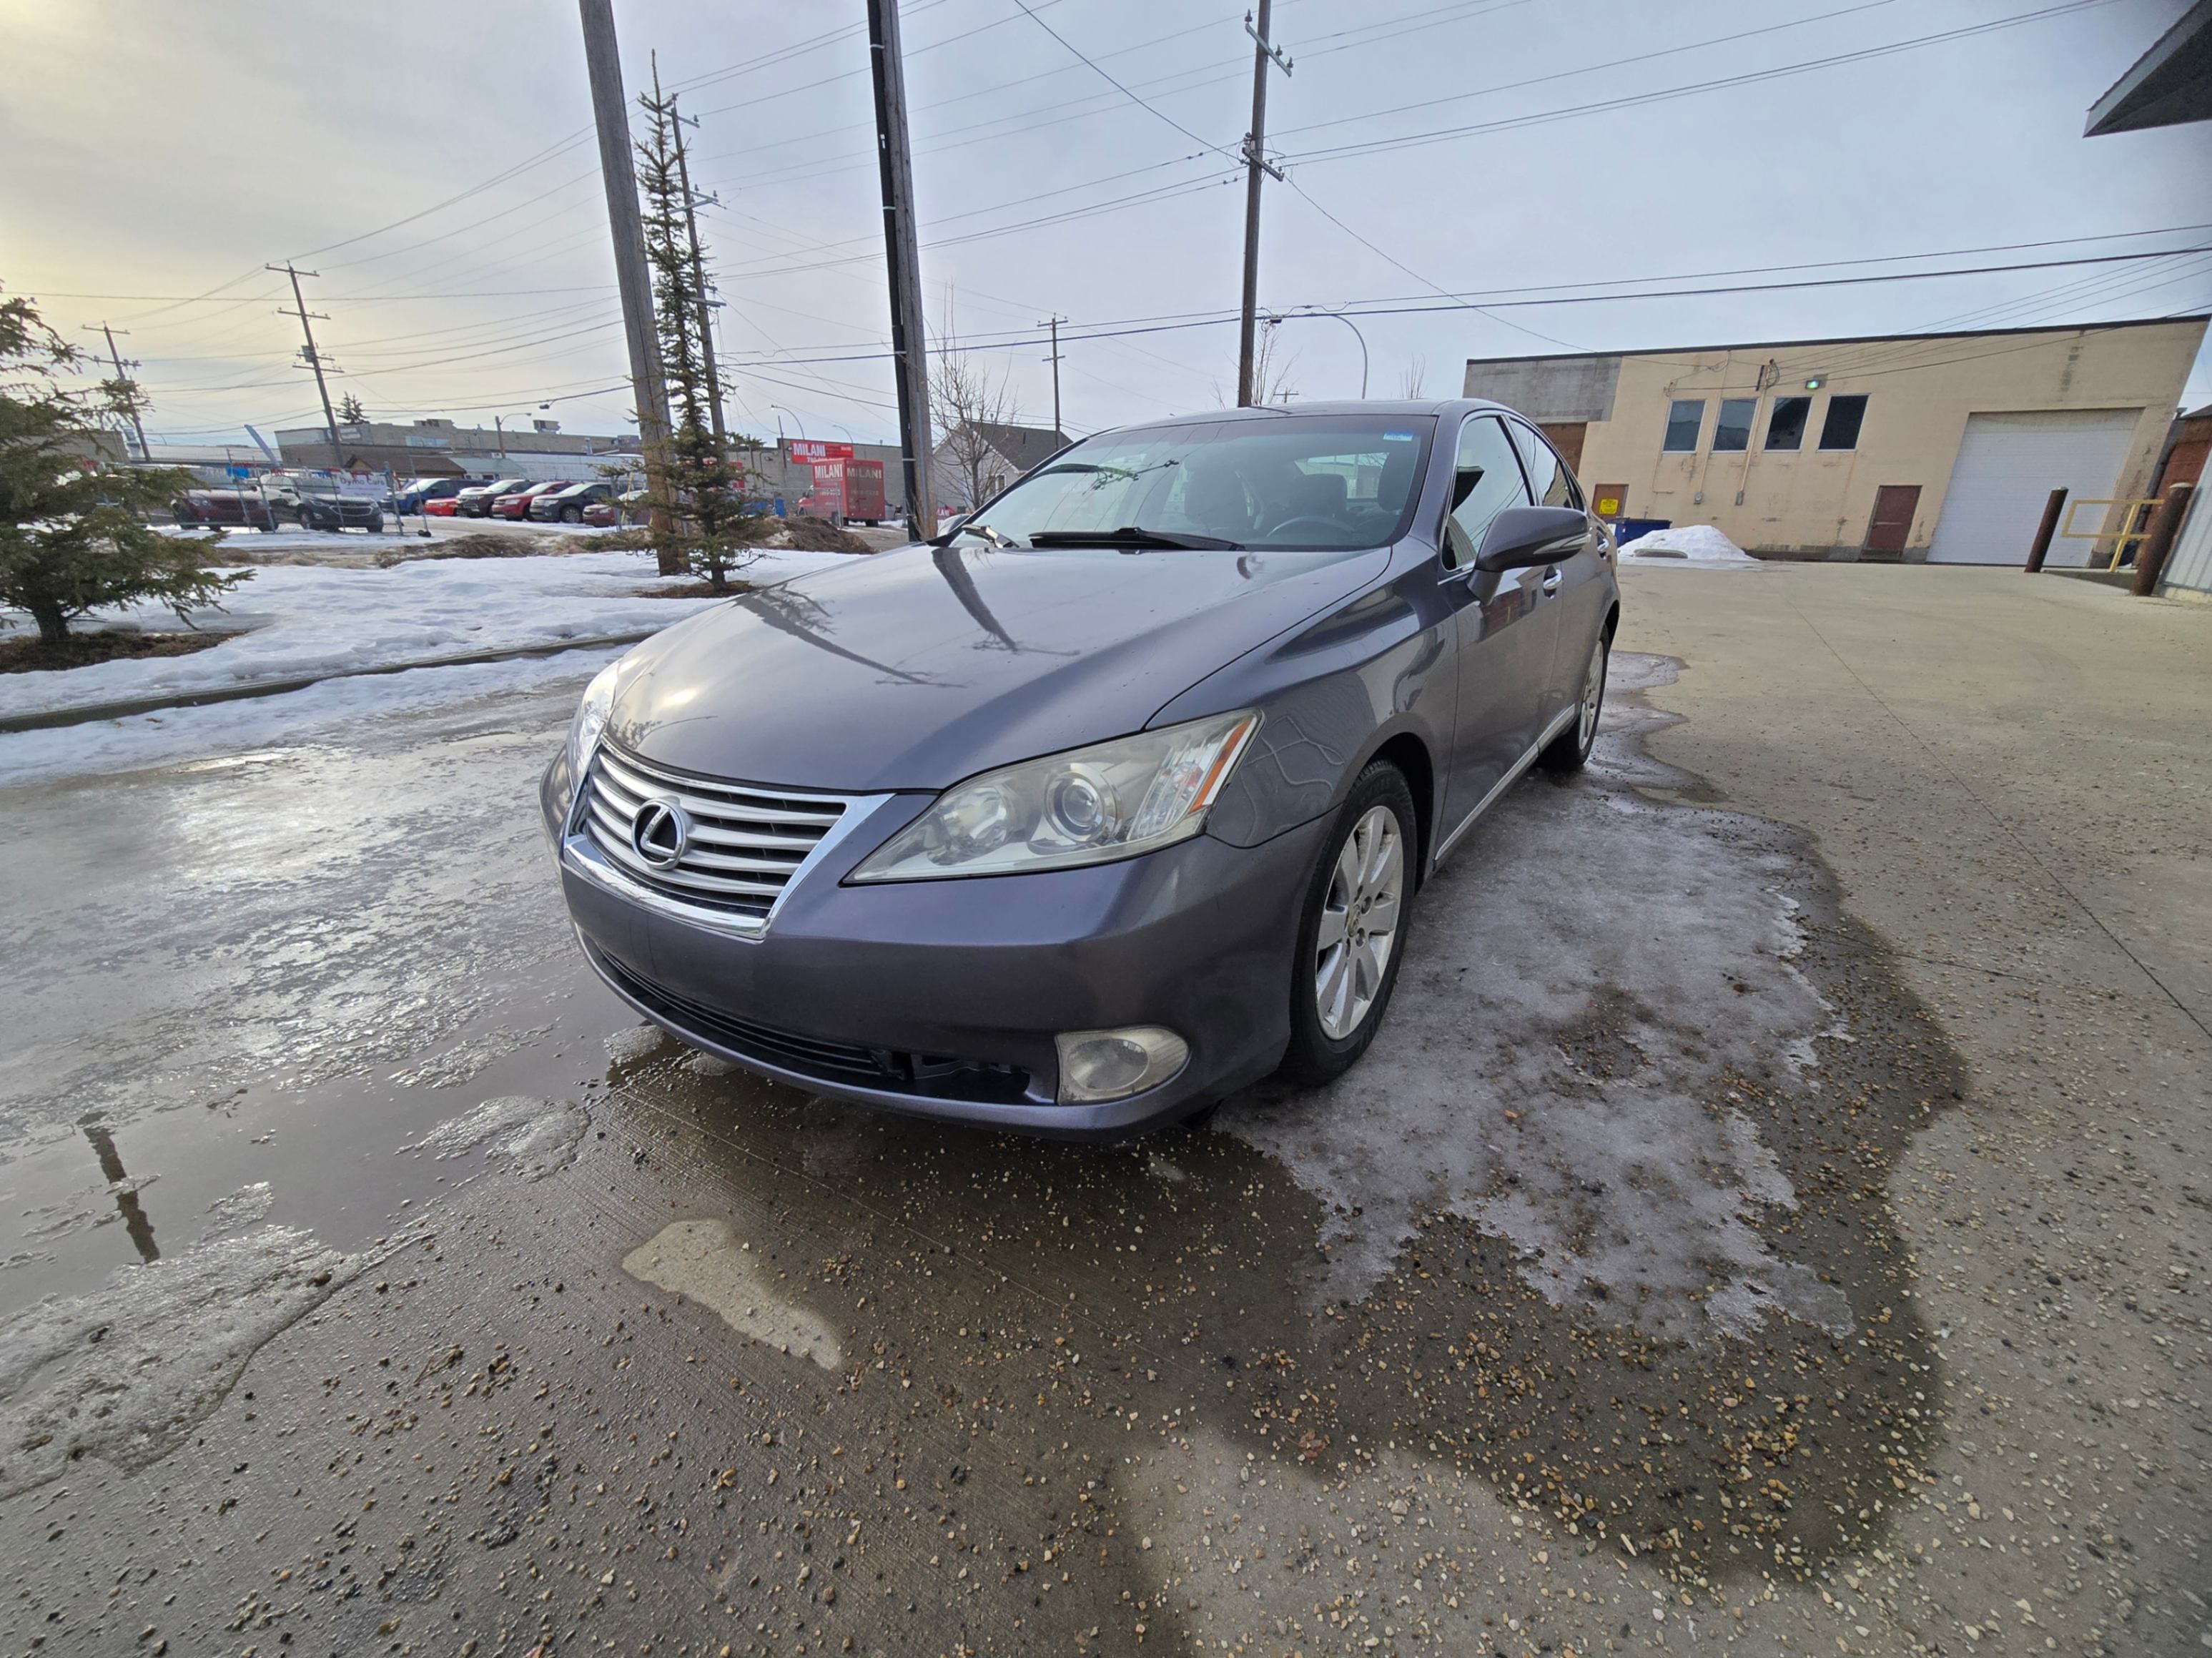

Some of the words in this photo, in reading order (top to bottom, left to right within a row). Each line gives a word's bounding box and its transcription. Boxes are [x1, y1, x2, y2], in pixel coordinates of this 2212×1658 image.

[793, 443, 826, 457] MILANI
[814, 463, 843, 478] MILANI
[846, 468, 882, 479] MILANI
